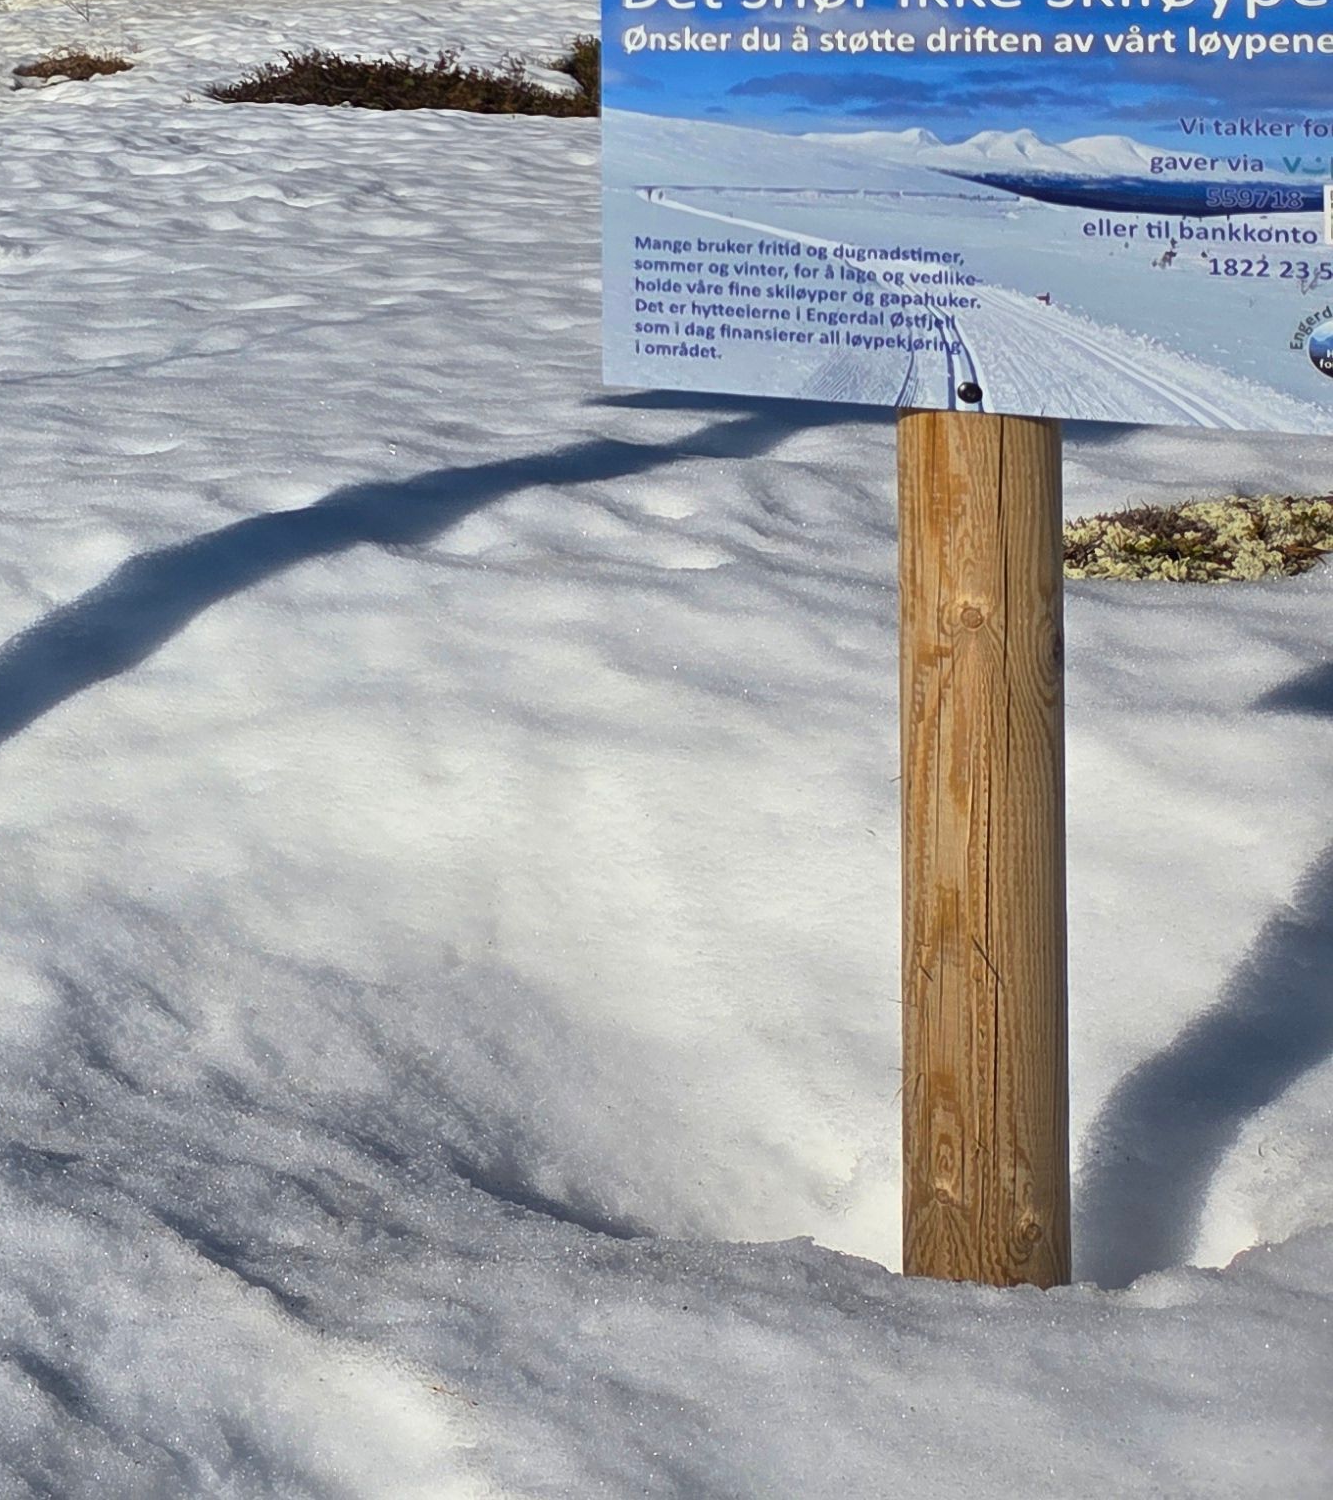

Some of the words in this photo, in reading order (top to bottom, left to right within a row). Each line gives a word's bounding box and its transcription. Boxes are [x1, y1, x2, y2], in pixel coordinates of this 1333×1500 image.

[623, 24, 732, 54] Ønsker
[741, 26, 782, 53] du
[791, 25, 809, 53] å
[819, 27, 916, 54] støtte
[927, 26, 1042, 53] driften
[1053, 32, 1094, 53] av
[1104, 25, 1176, 53] vårt
[1180, 117, 1205, 136] Vi
[1213, 118, 1295, 137] takker
[1303, 118, 1333, 138] fo
[1150, 156, 1219, 173] gaver
[1227, 155, 1264, 172] via
[1205, 187, 1304, 210] 559718
[1083, 219, 1138, 238] eller
[1146, 221, 1170, 239] til
[1179, 222, 1318, 245] bankkonto
[634, 236, 692, 254] Mange
[697, 238, 753, 255] bruker
[758, 240, 801, 257] fritid
[806, 245, 828, 260] og
[833, 244, 965, 265] dugnadstimer,
[634, 260, 703, 274] sommer
[708, 262, 729, 277] og
[734, 261, 789, 279] vinter,
[794, 263, 819, 279] for
[824, 263, 835, 280] å
[841, 267, 877, 284] lage
[882, 271, 904, 286] og
[910, 269, 983, 287] vedlike-
[1208, 258, 1270, 278] 1822
[1279, 261, 1309, 279] 23
[635, 278, 682, 294] holde
[686, 279, 723, 296] våre
[728, 280, 761, 298] fine
[766, 283, 846, 303] skiløyper
[853, 290, 875, 306] og
[879, 291, 982, 310] gapahuker.
[635, 298, 664, 313] Det
[669, 302, 687, 315] er
[691, 301, 791, 320] hytteeierne
[796, 306, 801, 321] i
[806, 307, 885, 327] Engerdal
[890, 311, 957, 331] Østfjell
[635, 321, 670, 335] som
[674, 320, 679, 335] i
[685, 322, 715, 340] dag
[720, 324, 814, 345] finansierer
[819, 328, 840, 346] all
[845, 328, 961, 355] løypekjøring
[635, 339, 640, 353] i
[645, 342, 723, 359] området.
